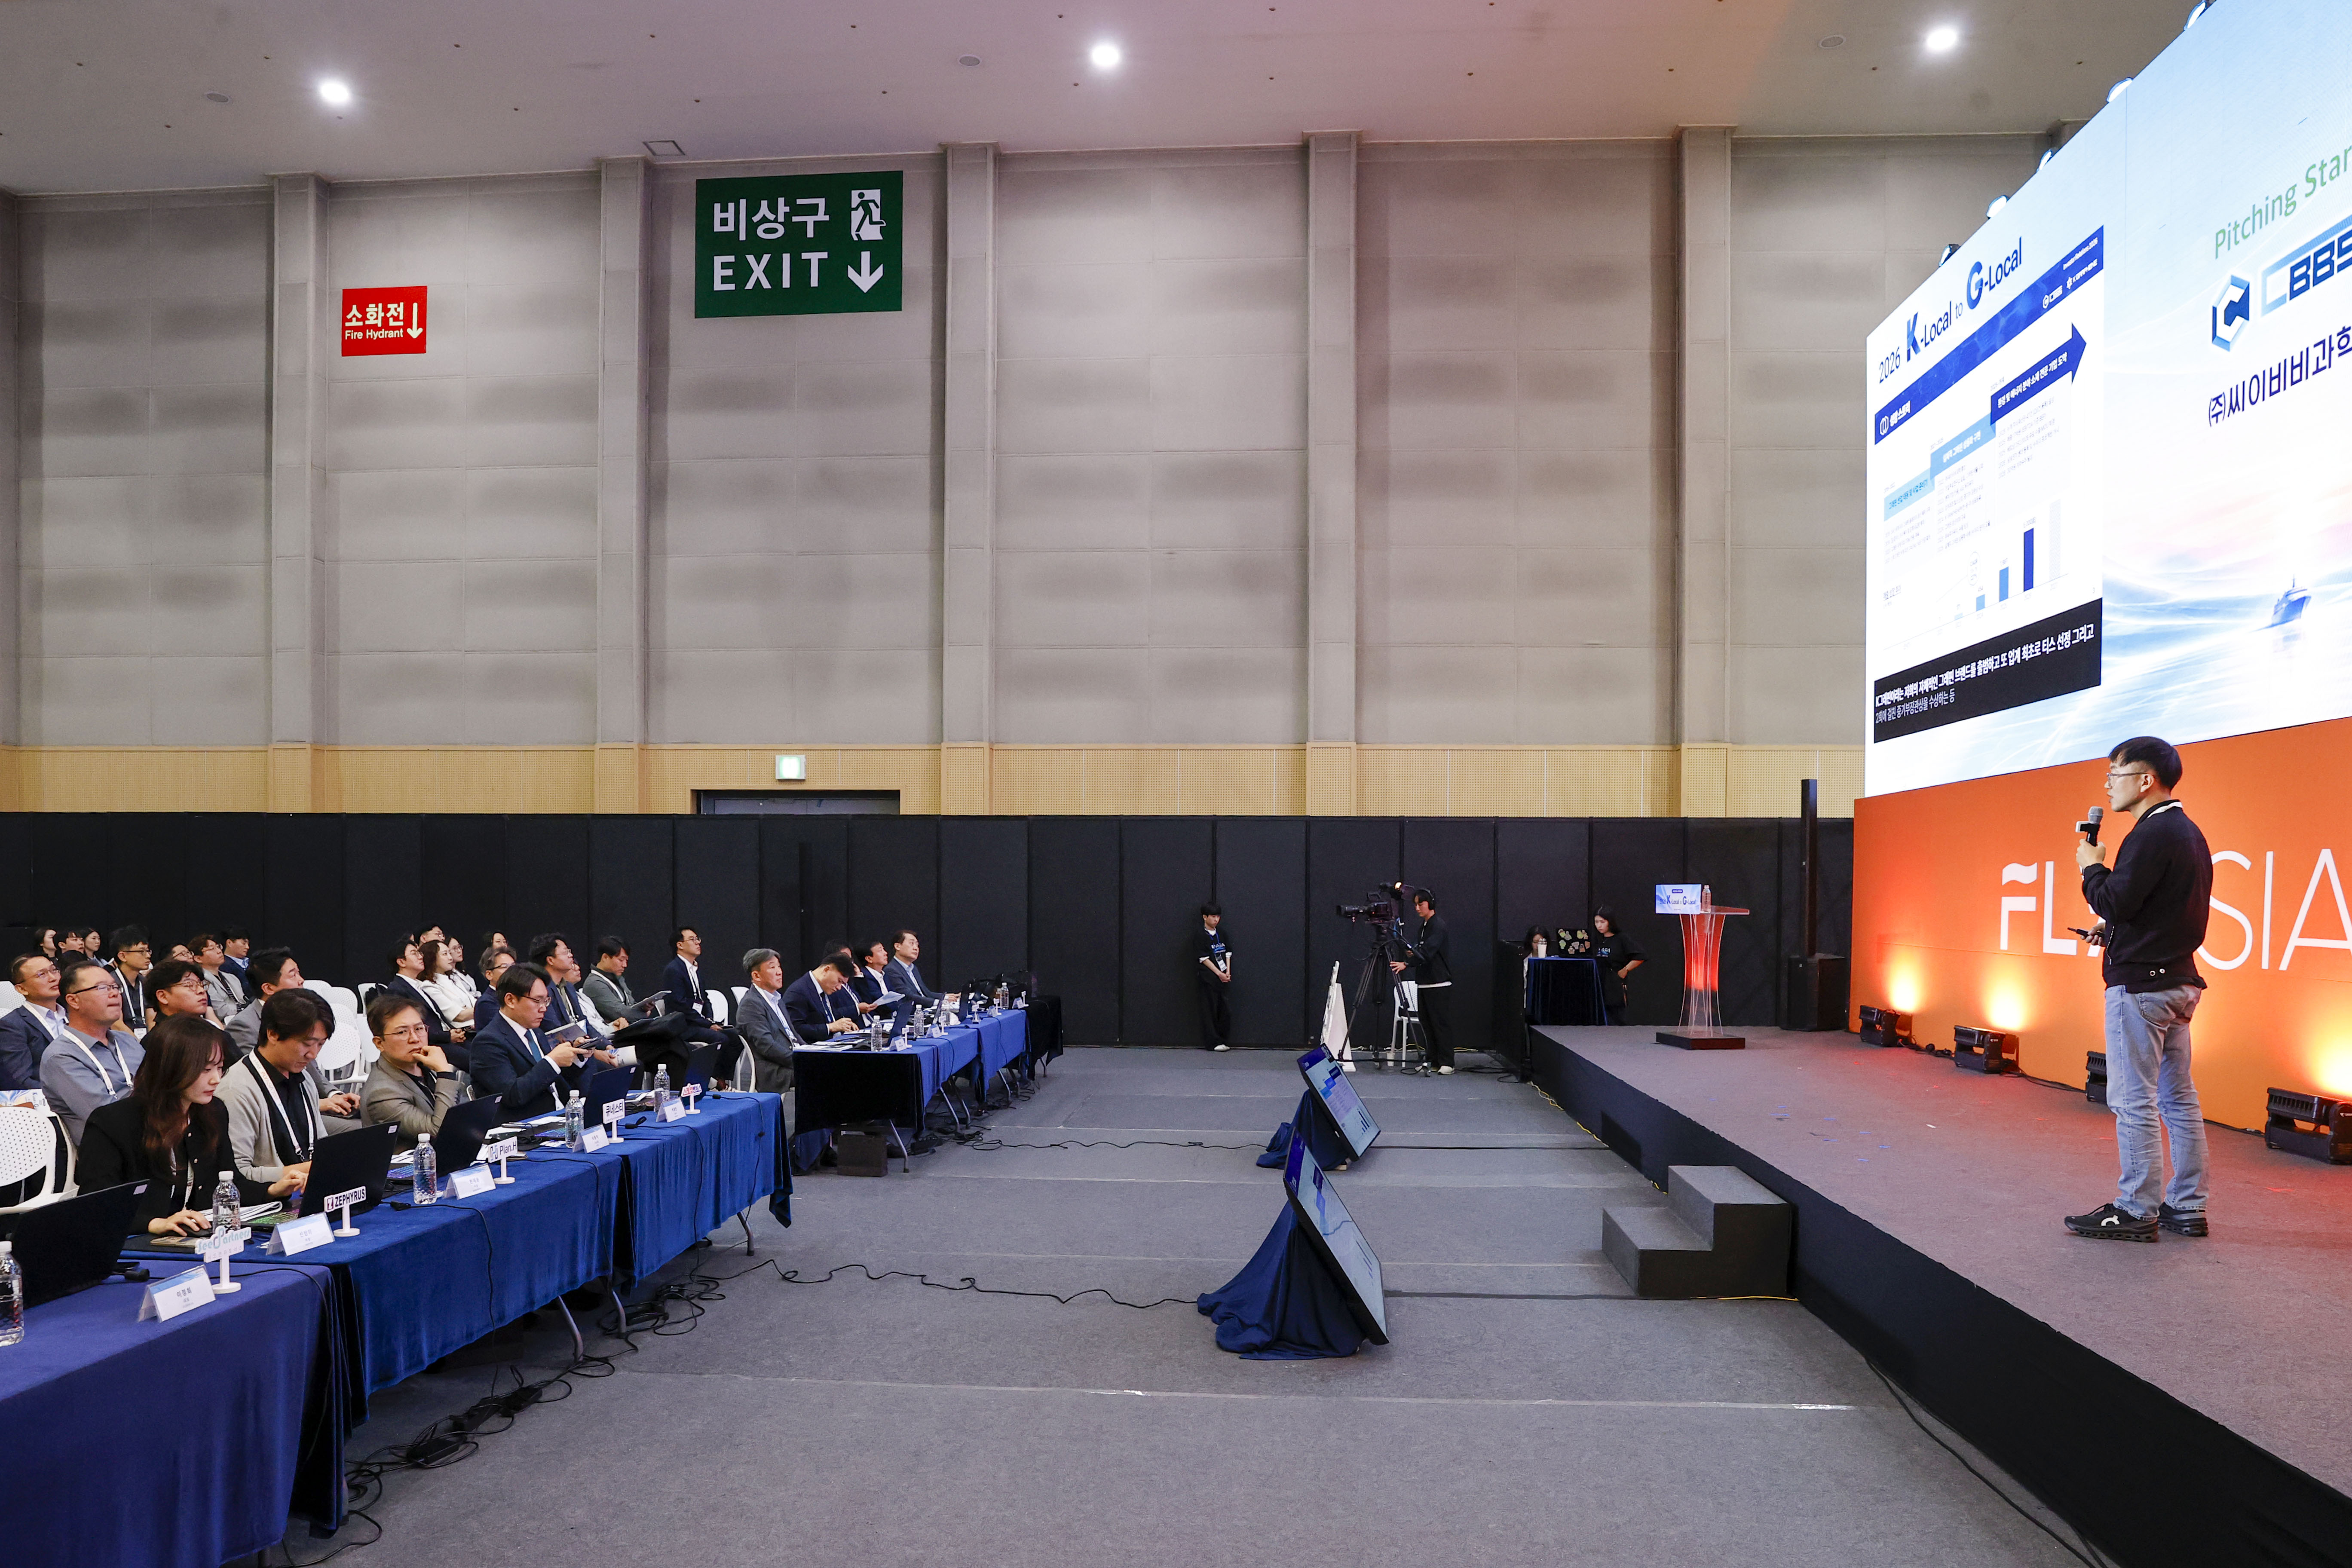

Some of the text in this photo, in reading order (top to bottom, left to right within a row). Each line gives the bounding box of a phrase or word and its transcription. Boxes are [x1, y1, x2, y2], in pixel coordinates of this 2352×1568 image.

[2215, 145, 2352, 259] Pitching Star
[714, 197, 830, 241] 비상구
[714, 251, 828, 291] EXIT
[345, 302, 404, 327] 소화전
[1879, 236, 2021, 384] 2026 K-Local to G-Local
[345, 328, 403, 340] Fire Hydrant
[2049, 358, 2057, 374] 기업
[1898, 399, 1910, 422] 스토리
[1904, 681, 1918, 699] 저희의
[1919, 674, 1938, 695] 자체적인
[1939, 669, 1954, 689] 그래핀
[1955, 662, 1976, 683] 브랜드를
[1977, 653, 1999, 676] 출범하고
[2000, 651, 2007, 669] 또
[2008, 646, 2021, 666] 업계
[2022, 639, 2041, 662] 최초로
[2042, 634, 2055, 655] 티스
[2057, 629, 2070, 651] 선정
[2072, 621, 2094, 646] 그리고
[1876, 688, 1954, 725] 2회에 걸친 중기부장관상을 수상하는 등
[2000, 849, 2352, 971] FLSIA
[606, 1101, 624, 1117] 큐네스티
[499, 1141, 517, 1155] Plan.H
[335, 1189, 365, 1207] ZEPHYRUS
